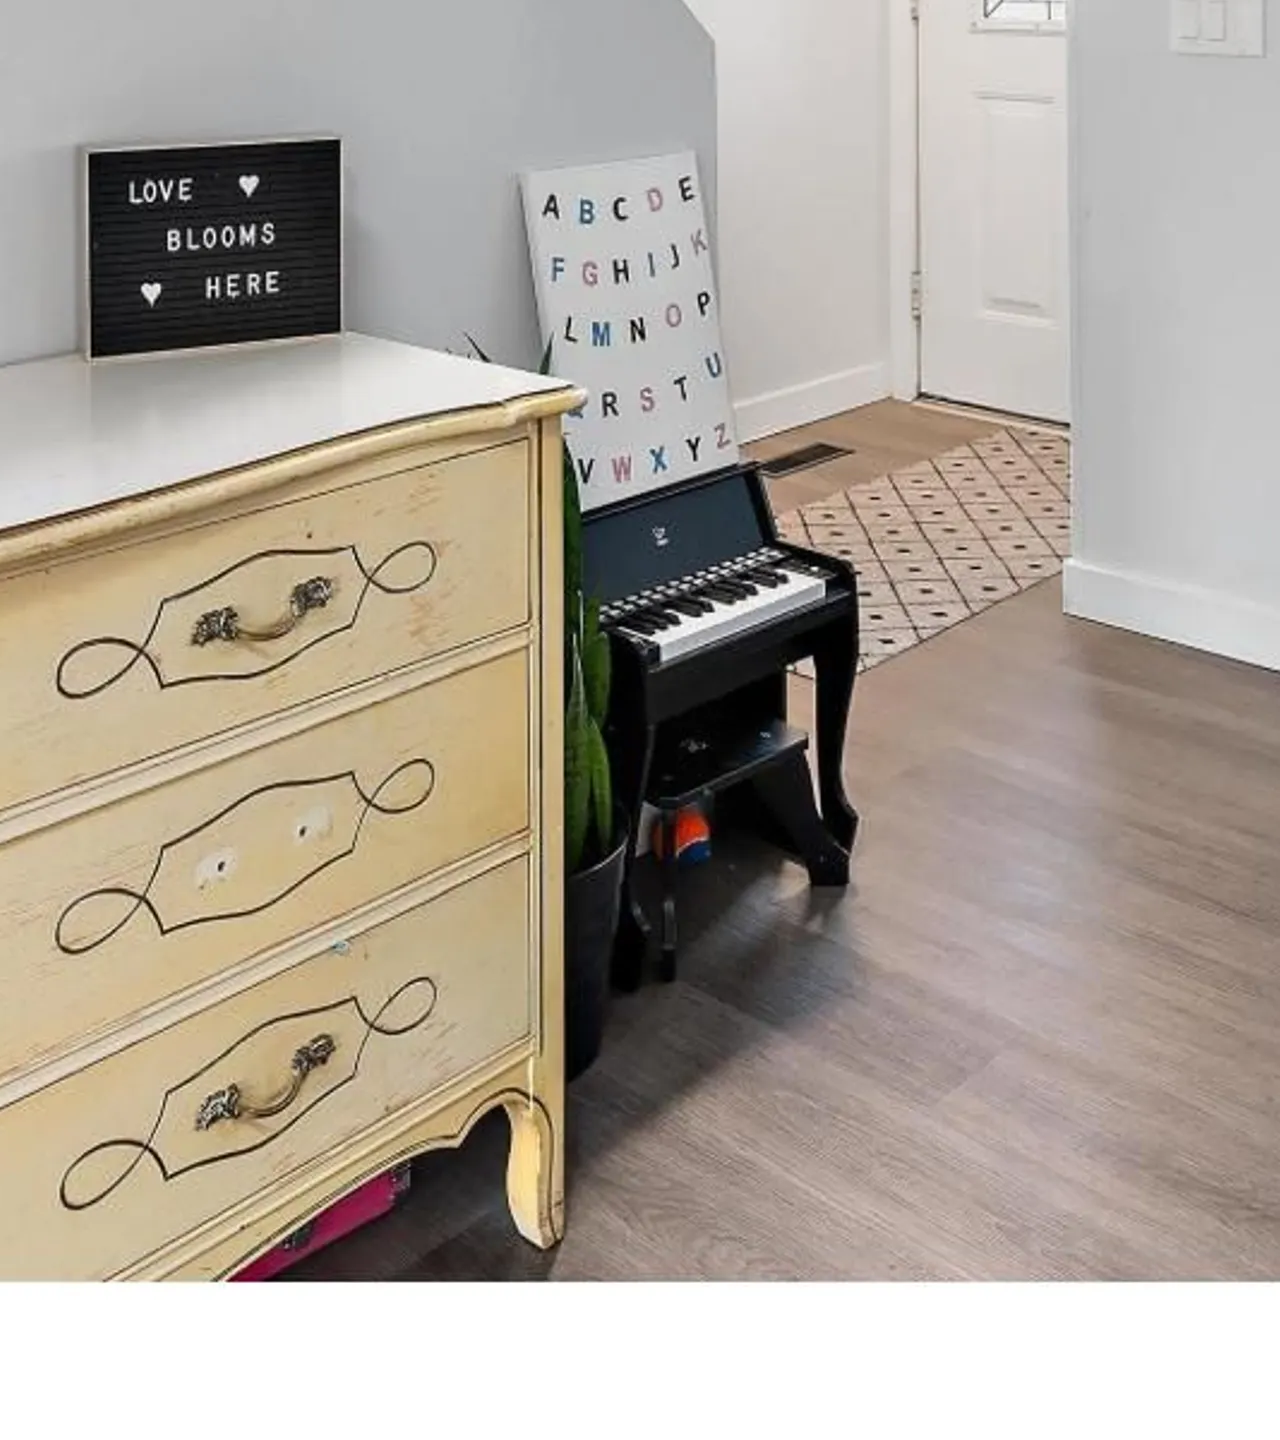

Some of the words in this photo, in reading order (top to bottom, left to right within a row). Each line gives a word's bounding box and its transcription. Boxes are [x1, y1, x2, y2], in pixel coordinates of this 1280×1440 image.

[128, 177, 193, 204] LOVE
[542, 193, 560, 220] A
[579, 198, 595, 224] B
[613, 196, 629, 221] C
[647, 187, 664, 212] D
[678, 176, 695, 202] E
[166, 222, 276, 252] BLOOMS
[550, 257, 565, 282] F
[582, 261, 598, 287] G
[613, 259, 629, 284] H
[647, 252, 656, 277] I
[670, 243, 680, 269] J
[690, 228, 708, 256] K
[205, 270, 280, 299] HERE
[563, 315, 578, 343] L
[591, 321, 611, 347] M
[629, 317, 646, 343] N
[665, 303, 682, 328] O
[697, 291, 712, 317] P
[601, 392, 619, 418] R
[639, 387, 656, 412] S
[673, 375, 688, 401] T
[704, 352, 722, 378] U
[577, 457, 595, 484] V
[612, 455, 632, 483] W
[649, 446, 668, 474] X
[685, 436, 701, 462] Y
[714, 423, 732, 450] Z
